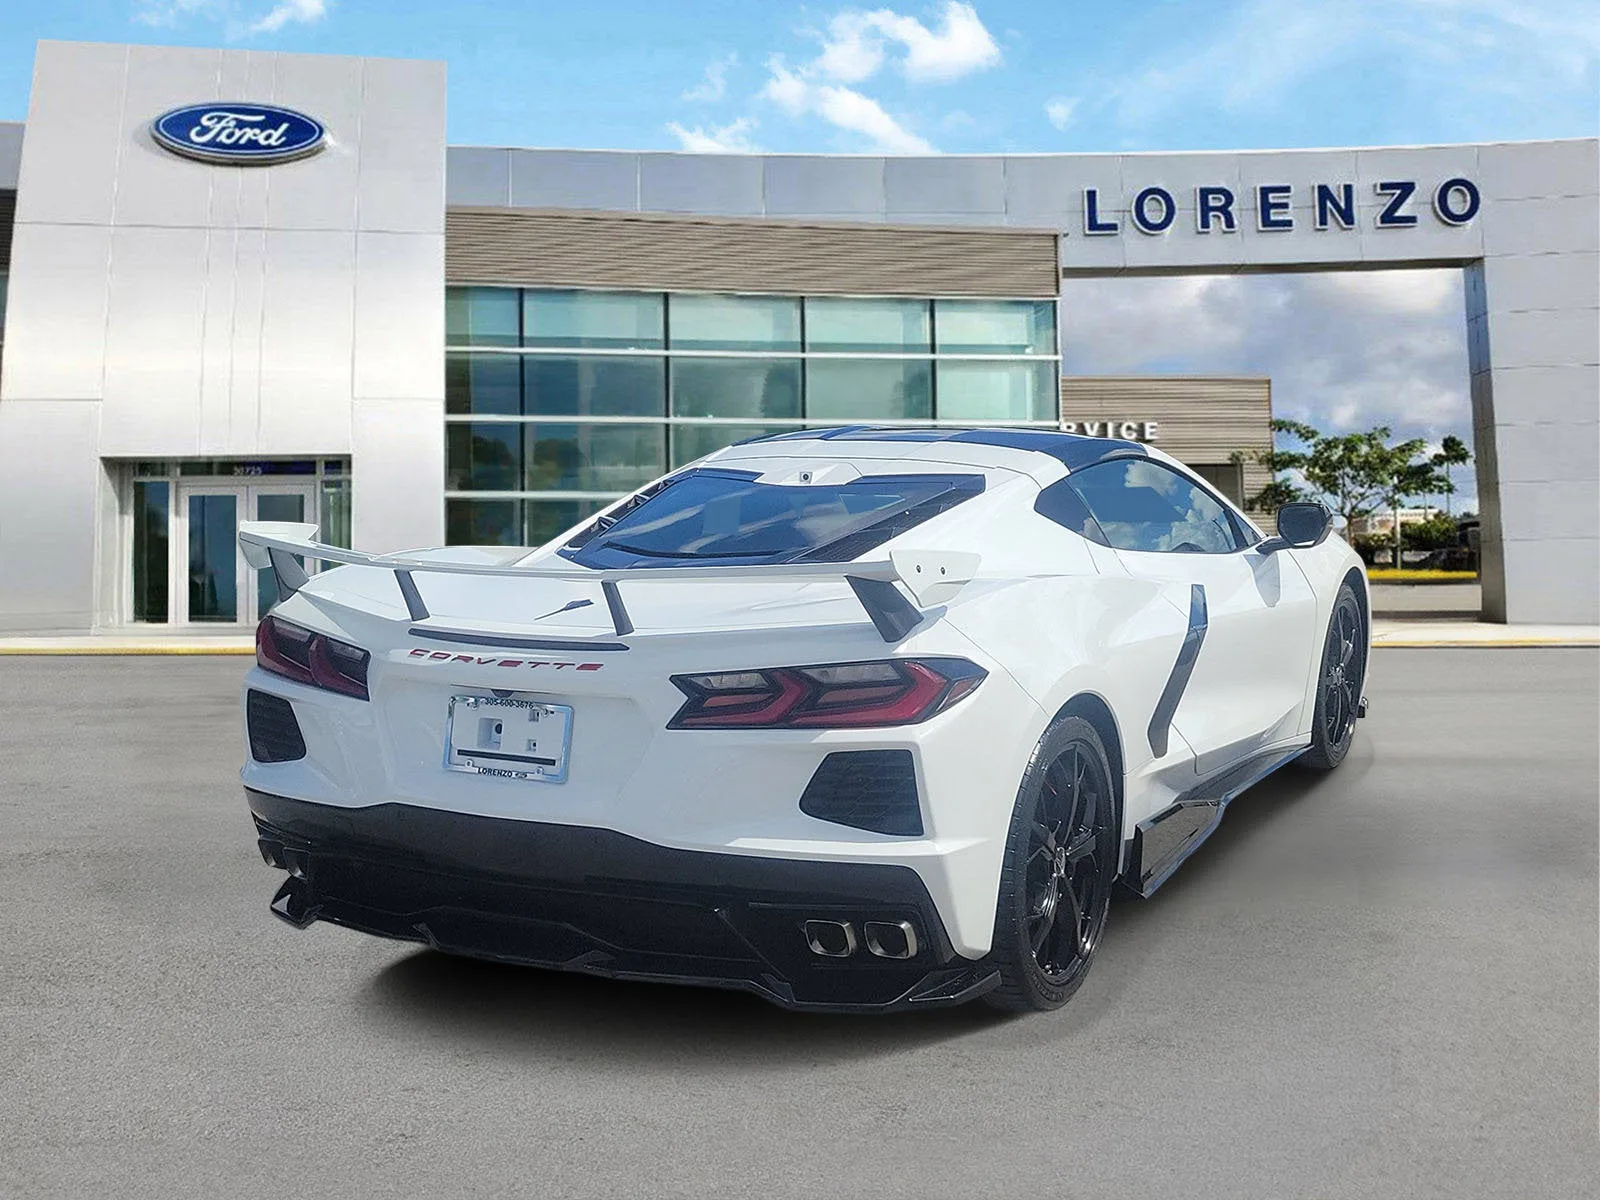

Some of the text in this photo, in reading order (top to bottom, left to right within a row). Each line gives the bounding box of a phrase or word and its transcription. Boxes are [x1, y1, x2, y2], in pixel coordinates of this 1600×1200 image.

[189, 111, 290, 146] Ford
[1083, 178, 1481, 235] LORENZO
[1060, 421, 1160, 440] RVICE
[408, 648, 604, 671] CORVETTE
[477, 767, 513, 778] LORENZO
